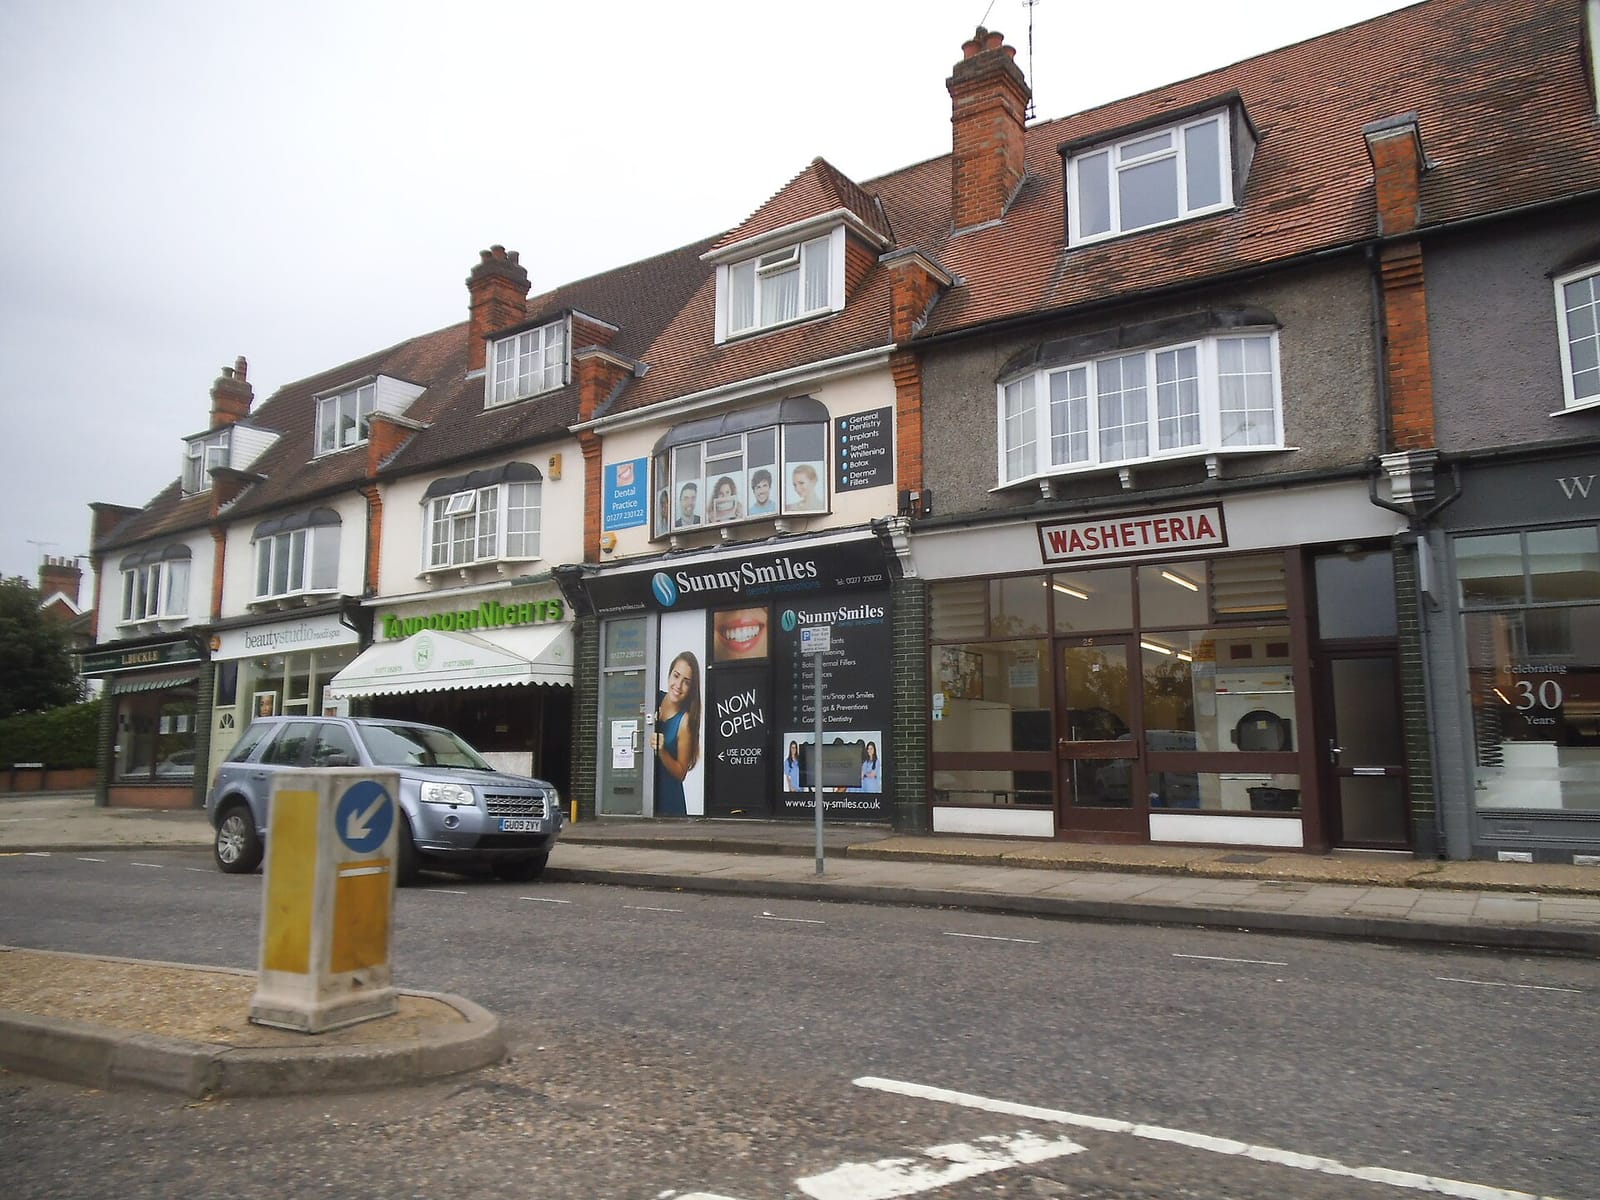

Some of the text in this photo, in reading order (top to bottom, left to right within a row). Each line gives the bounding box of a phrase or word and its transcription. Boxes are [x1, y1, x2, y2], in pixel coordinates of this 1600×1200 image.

[849, 412, 879, 424] General
[849, 420, 881, 432] Dentistry
[849, 430, 879, 441] Implants
[850, 442, 869, 452] Teeth
[850, 448, 885, 459] Whitening
[849, 460, 869, 469] Botox
[849, 468, 877, 479] Dermal
[849, 478, 869, 486] Fillers
[614, 487, 636, 498] Dental
[612, 500, 638, 511] Practice
[606, 509, 644, 522] 01277 230122
[1047, 515, 1216, 554] WASHETERIA
[675, 557, 817, 594] SunnySmiles
[797, 605, 884, 625] SunnySmiles
[1503, 663, 1567, 674] Celebrating
[855, 691, 875, 699] Smiles
[1515, 680, 1562, 710] 30
[717, 688, 756, 718] NOW
[720, 708, 764, 737] OPEN
[828, 715, 853, 724] Dentistry
[1524, 715, 1556, 725] Years
[726, 748, 762, 757] USE DOOR
[730, 757, 757, 765] ON LEFT
[504, 820, 524, 830] GU09
